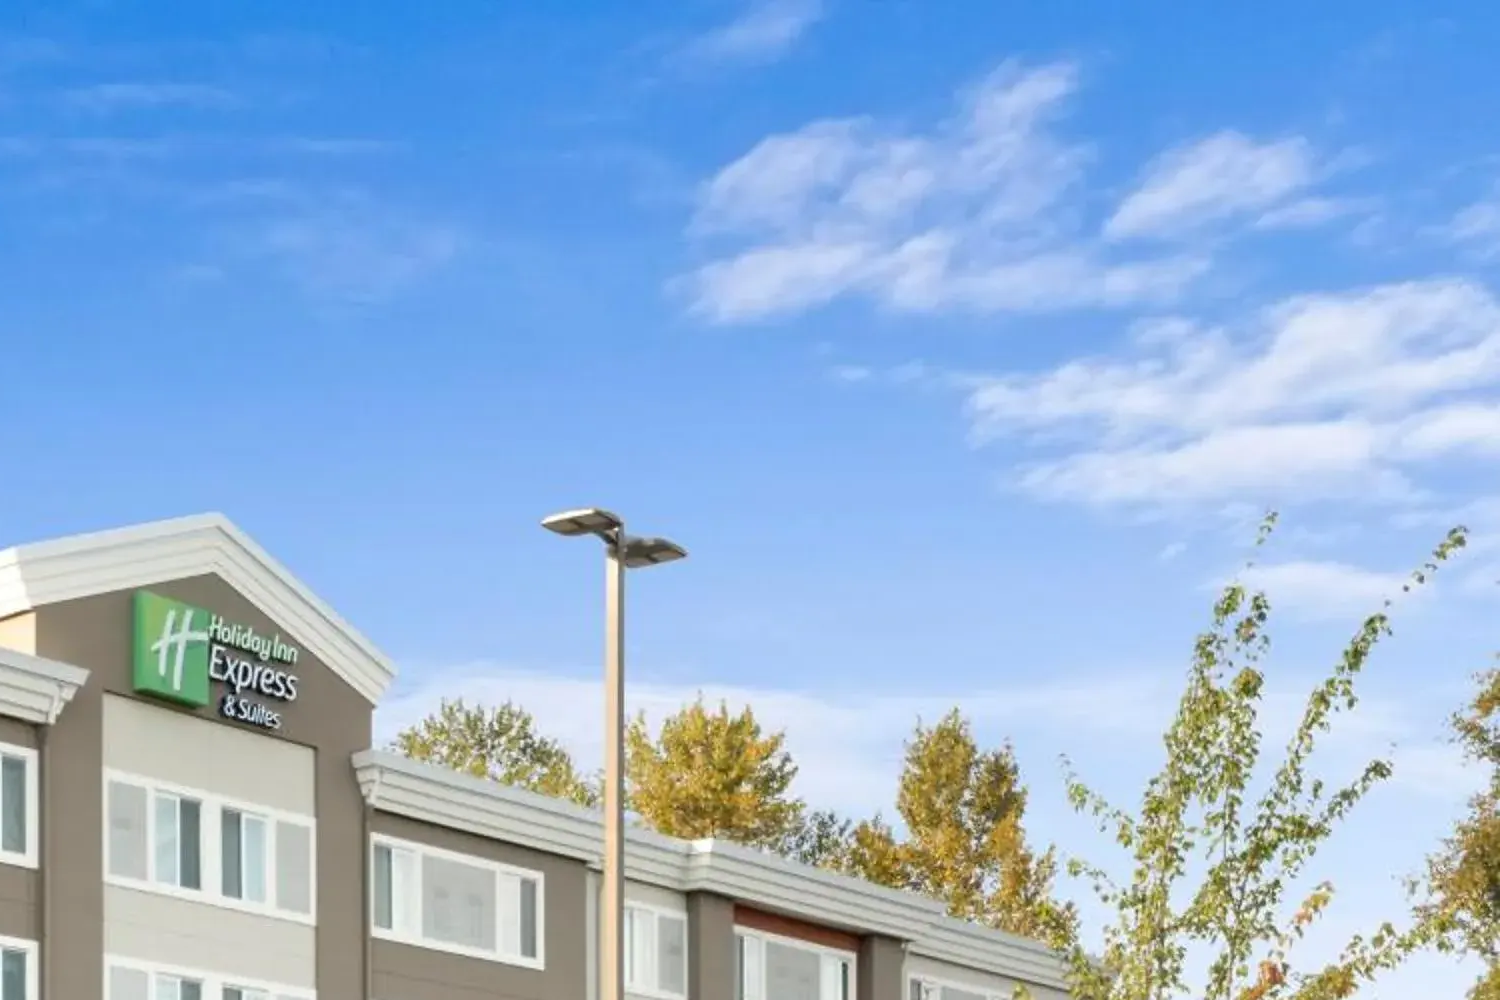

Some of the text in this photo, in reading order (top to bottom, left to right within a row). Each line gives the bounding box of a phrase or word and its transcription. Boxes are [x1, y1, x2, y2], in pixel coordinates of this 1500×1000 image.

[208, 615, 298, 664] Holiday Inn
[209, 644, 298, 700] Express
[223, 695, 281, 729] & Suites
